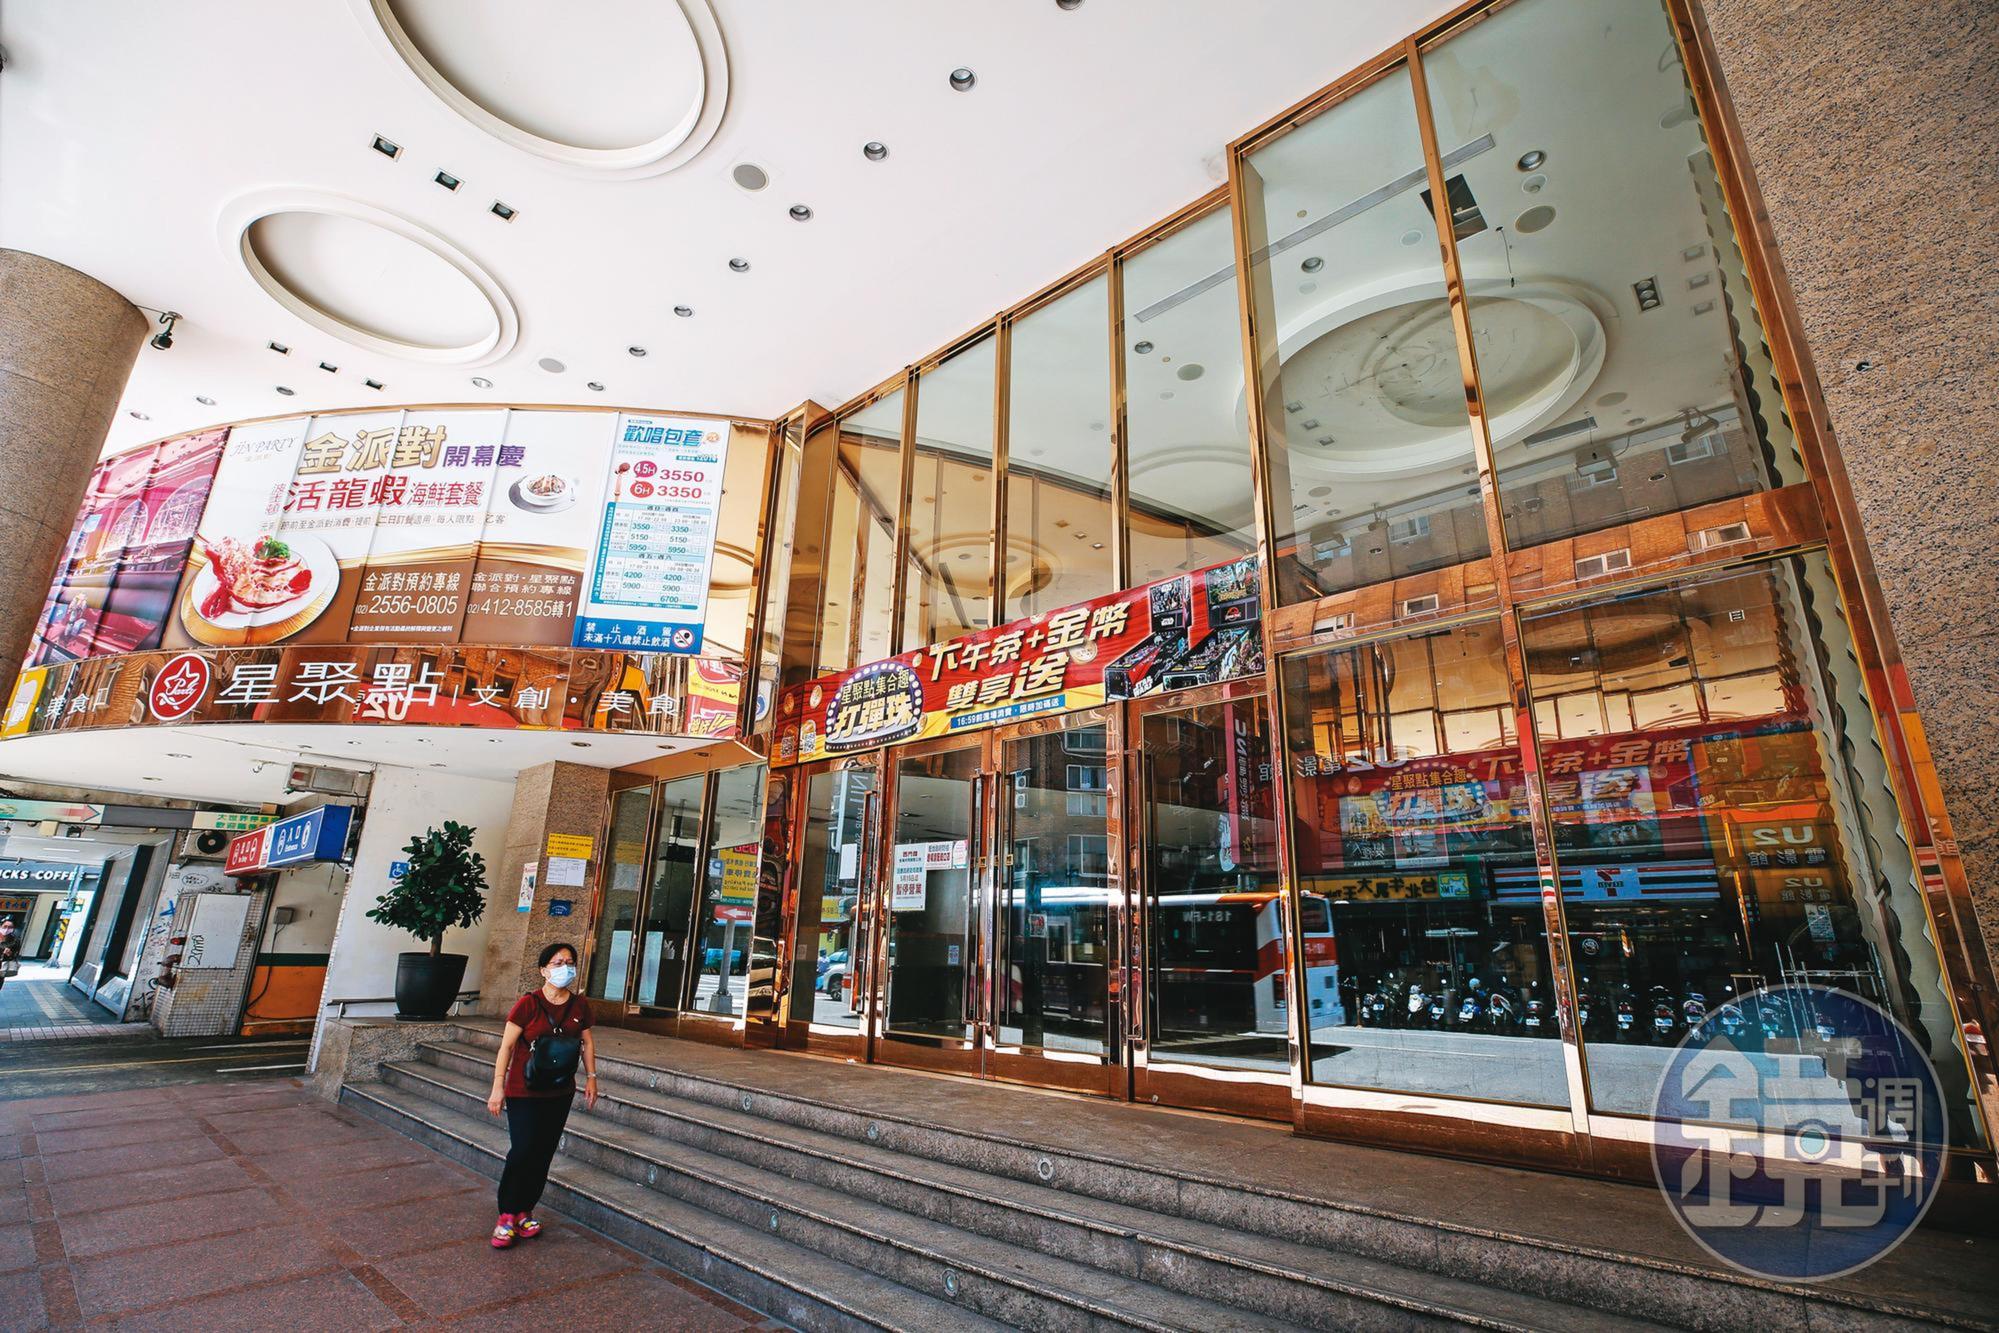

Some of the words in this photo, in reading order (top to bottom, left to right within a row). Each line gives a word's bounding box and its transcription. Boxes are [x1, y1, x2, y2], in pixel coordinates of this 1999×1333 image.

[255, 436, 297, 453] PARTY
[624, 425, 703, 447] 歡唱包套
[297, 426, 446, 475] 金派對
[442, 446, 526, 468] 開幕慶
[660, 469, 704, 483] 3550
[283, 475, 408, 513] 活龍蝦
[407, 481, 484, 508] 海鮮套餐
[657, 486, 702, 499] 3350
[632, 523, 651, 531] 3550
[668, 546, 687, 554] 5950
[363, 571, 461, 592] 金派對預約專線
[621, 582, 641, 590] 5900
[624, 571, 643, 579] 4200
[663, 574, 683, 582] 4200
[471, 582, 573, 595] 聯合預約專線
[368, 595, 458, 615] 2556-0805
[480, 598, 572, 618] 412-8585轉1
[585, 622, 673, 636] 禁止酒駕
[583, 633, 671, 648] 未滿十八歲禁止飲酒
[931, 600, 1131, 683] 下午茶+金幣
[166, 678, 196, 698] Party
[214, 662, 447, 706] 星聚點
[469, 685, 551, 711] 文創
[596, 690, 680, 717] 美食
[840, 668, 911, 705] 星聚點集合趣
[944, 654, 1072, 713] 雙享送
[45, 695, 88, 718] 美食
[828, 692, 914, 740] 打彈珠
[287, 826, 301, 841] 入口
